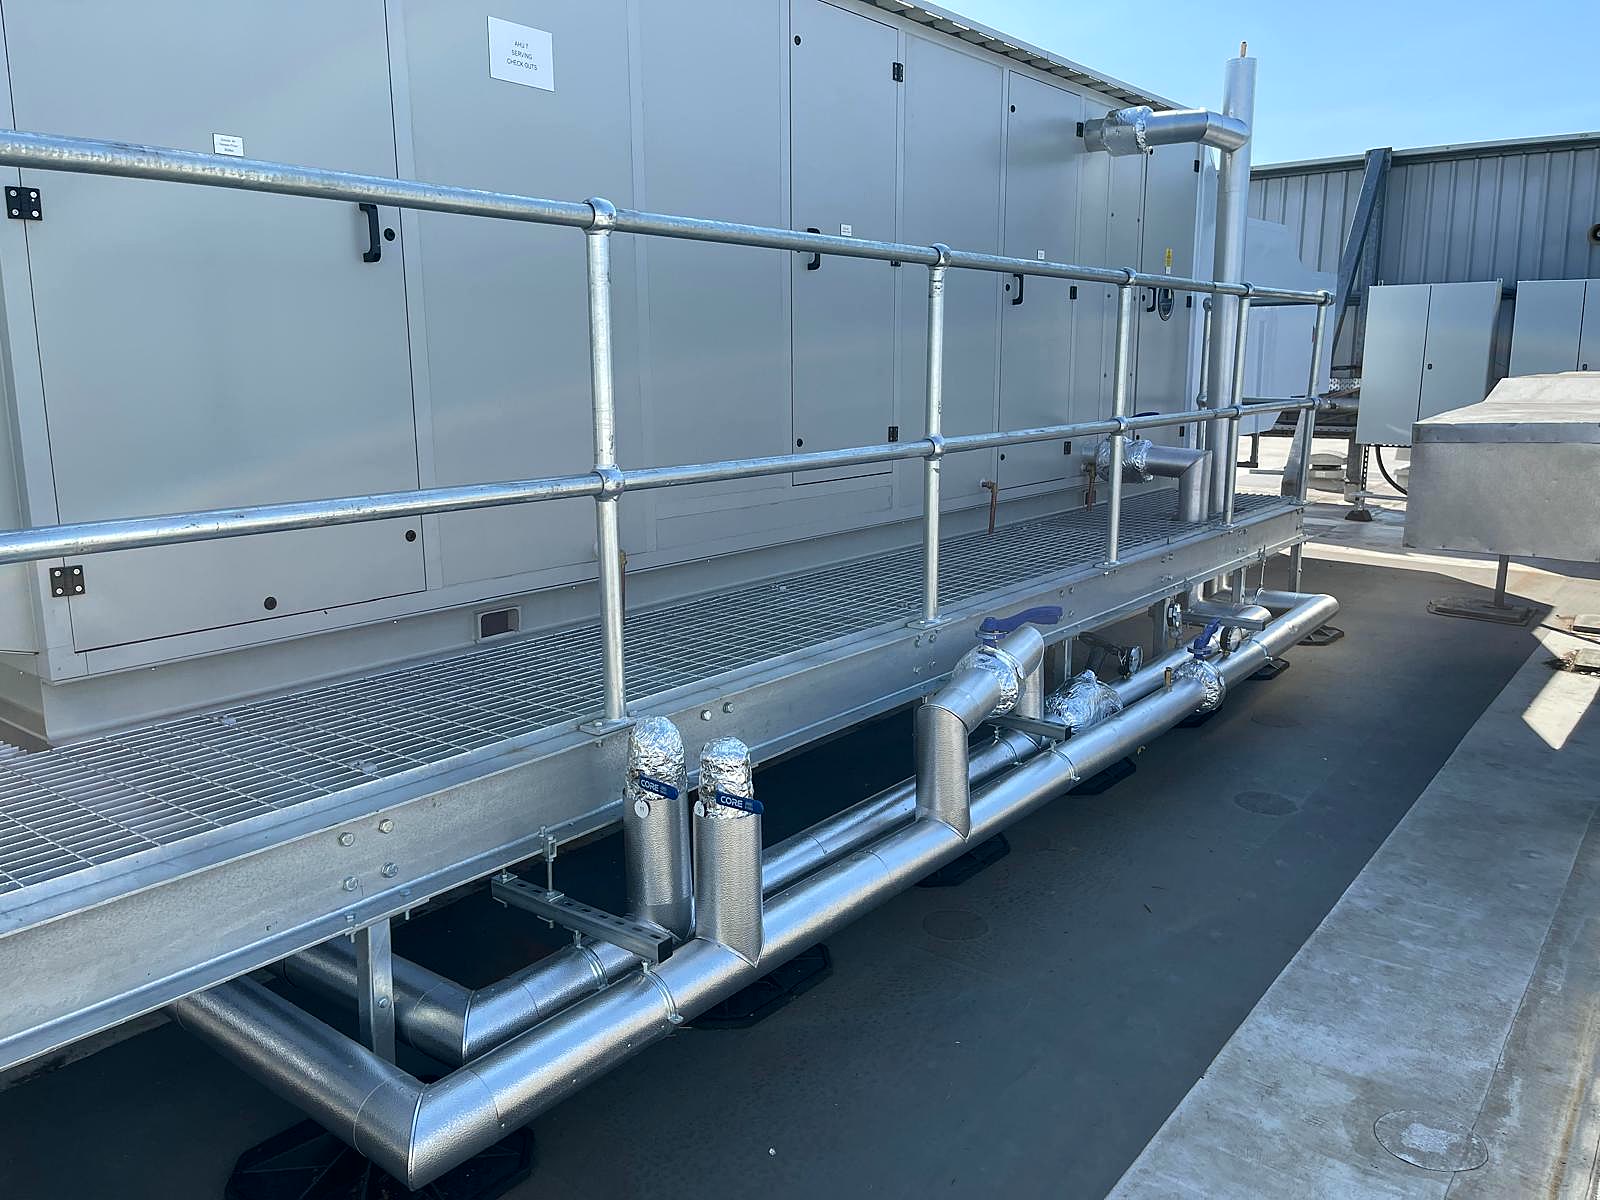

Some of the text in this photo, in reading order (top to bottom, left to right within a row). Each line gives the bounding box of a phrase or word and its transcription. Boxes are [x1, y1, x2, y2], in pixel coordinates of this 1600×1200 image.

[514, 41, 525, 49] AHU
[511, 49, 533, 60] SERVING
[506, 57, 538, 71] CHECK OUTS
[640, 779, 660, 792] CORE
[720, 795, 743, 809] CORE
